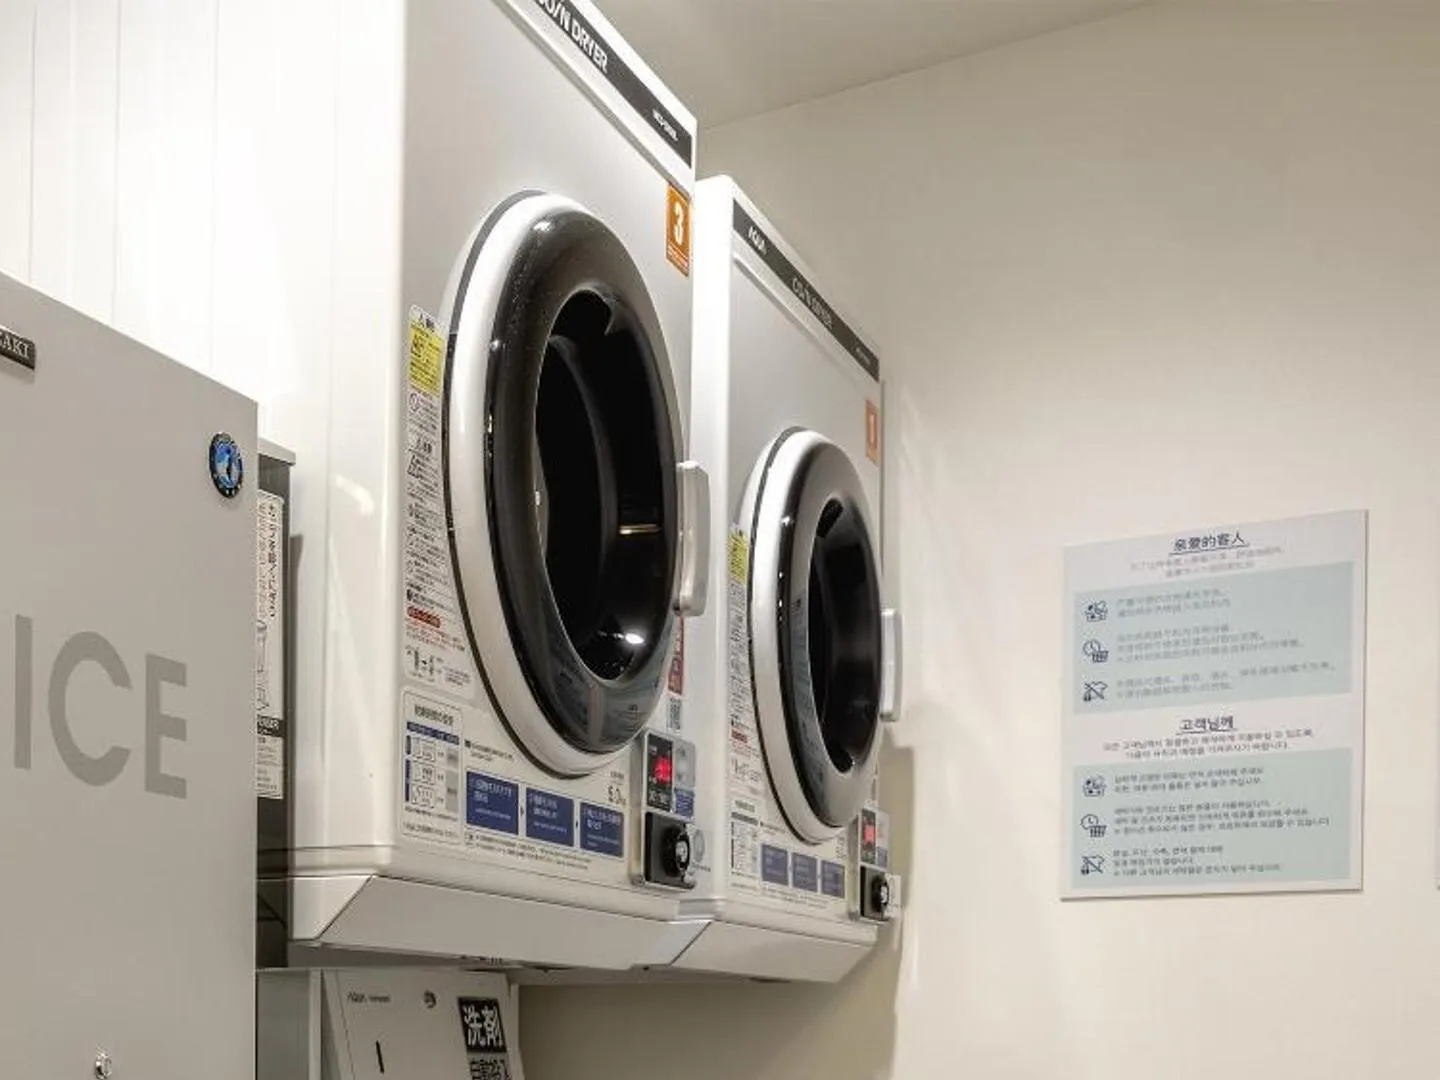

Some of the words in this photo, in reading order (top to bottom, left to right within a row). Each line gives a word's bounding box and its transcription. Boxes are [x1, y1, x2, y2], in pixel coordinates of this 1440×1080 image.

[536, 0, 571, 32] OIN
[571, 18, 608, 74] DRYER
[673, 201, 685, 246] 3
[14, 613, 187, 799] ICE
